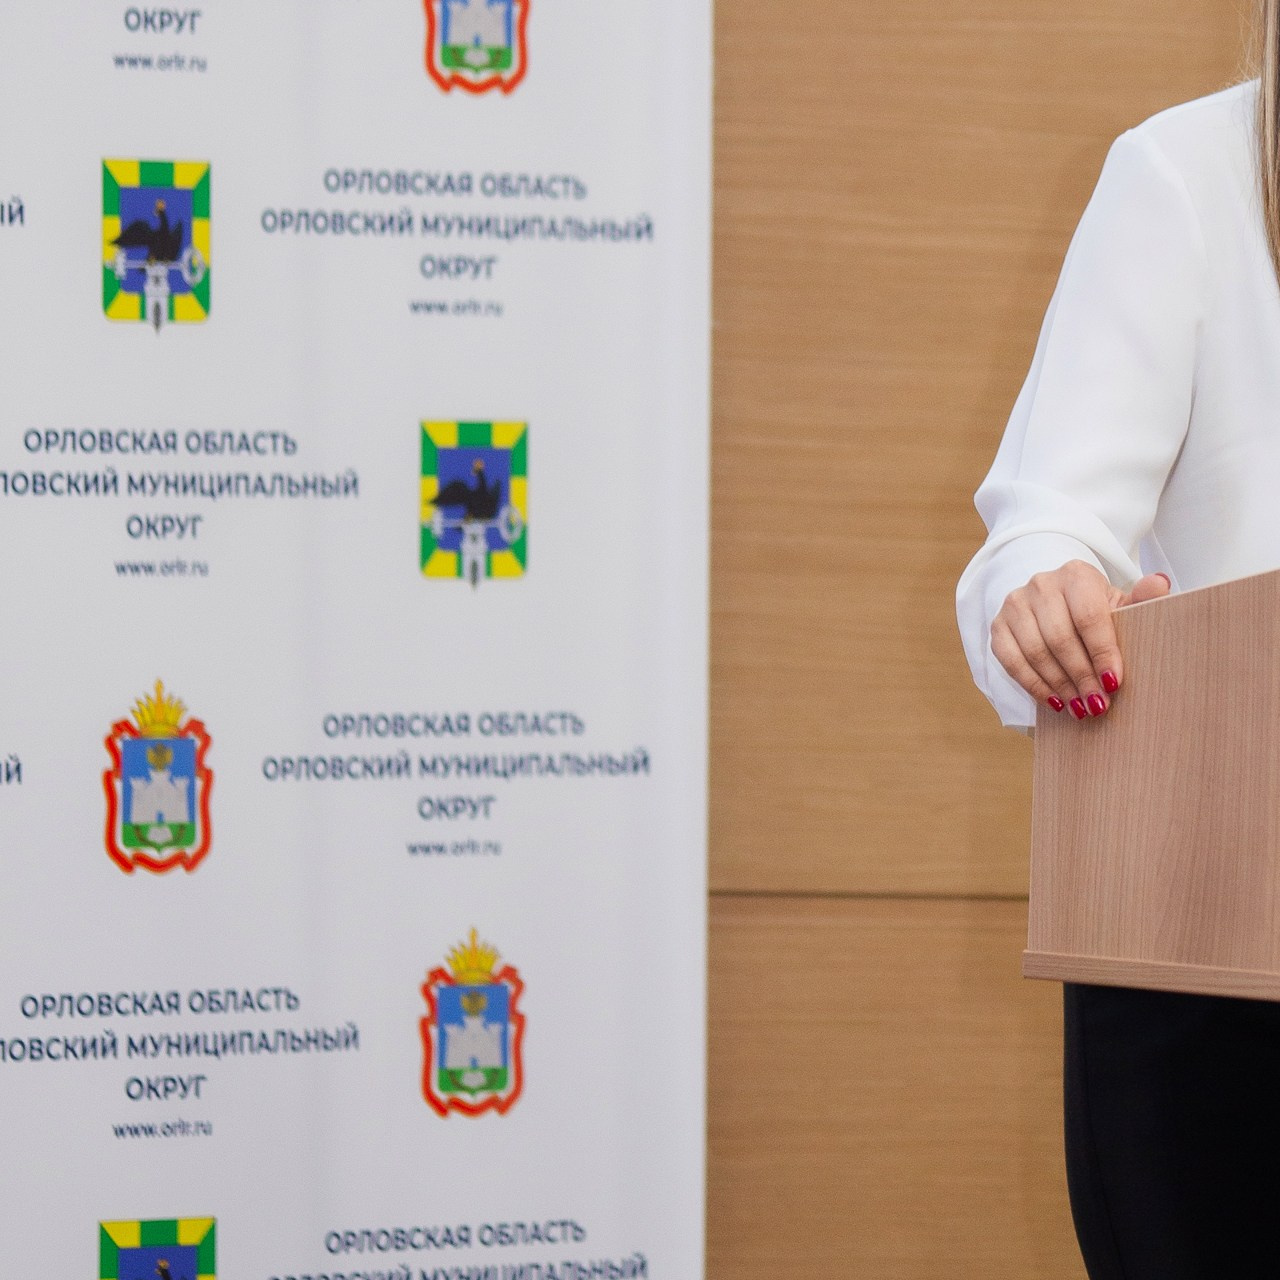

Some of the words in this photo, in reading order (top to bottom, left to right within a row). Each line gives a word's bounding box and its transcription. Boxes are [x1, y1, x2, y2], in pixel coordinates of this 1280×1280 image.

[123, 6, 202, 34] ОКРУГ
[323, 168, 474, 196] ОРЛОВСКАЯ
[479, 172, 588, 200] ОБЛАСТЬ
[260, 207, 414, 236] ОРЛОВСКИЙ
[421, 212, 655, 243] МУНИЦИПАЛЬНЫЙ
[419, 254, 497, 280] ОКРУГ
[23, 427, 178, 455] ОРЛОВСКАЯ
[184, 429, 298, 456] ОБЛАСТЬ
[127, 468, 359, 502] МУНИЦИПАЛЬНЫЙ
[125, 514, 203, 540] ОКРУГ
[322, 712, 471, 739] ОРЛОВСКАЯ
[477, 711, 585, 737] ОБЛАСТЬ
[261, 750, 412, 782] ОРЛОВСКИЙ
[419, 746, 651, 781] МУНИЦИПАЛЬНЫЙ
[417, 795, 496, 821] ОКРУГ
[19, 990, 181, 1020] ОРЛОВСКАЯ
[187, 987, 300, 1015] ОБЛАСТЬ
[126, 1021, 360, 1060] МУНИЦИПАЛЬНЫЙ
[124, 1074, 208, 1102] ОКРУГ
[324, 1224, 472, 1255] ОРЛОВСКАЯ
[477, 1219, 587, 1248] ОБЛАСТЬ
